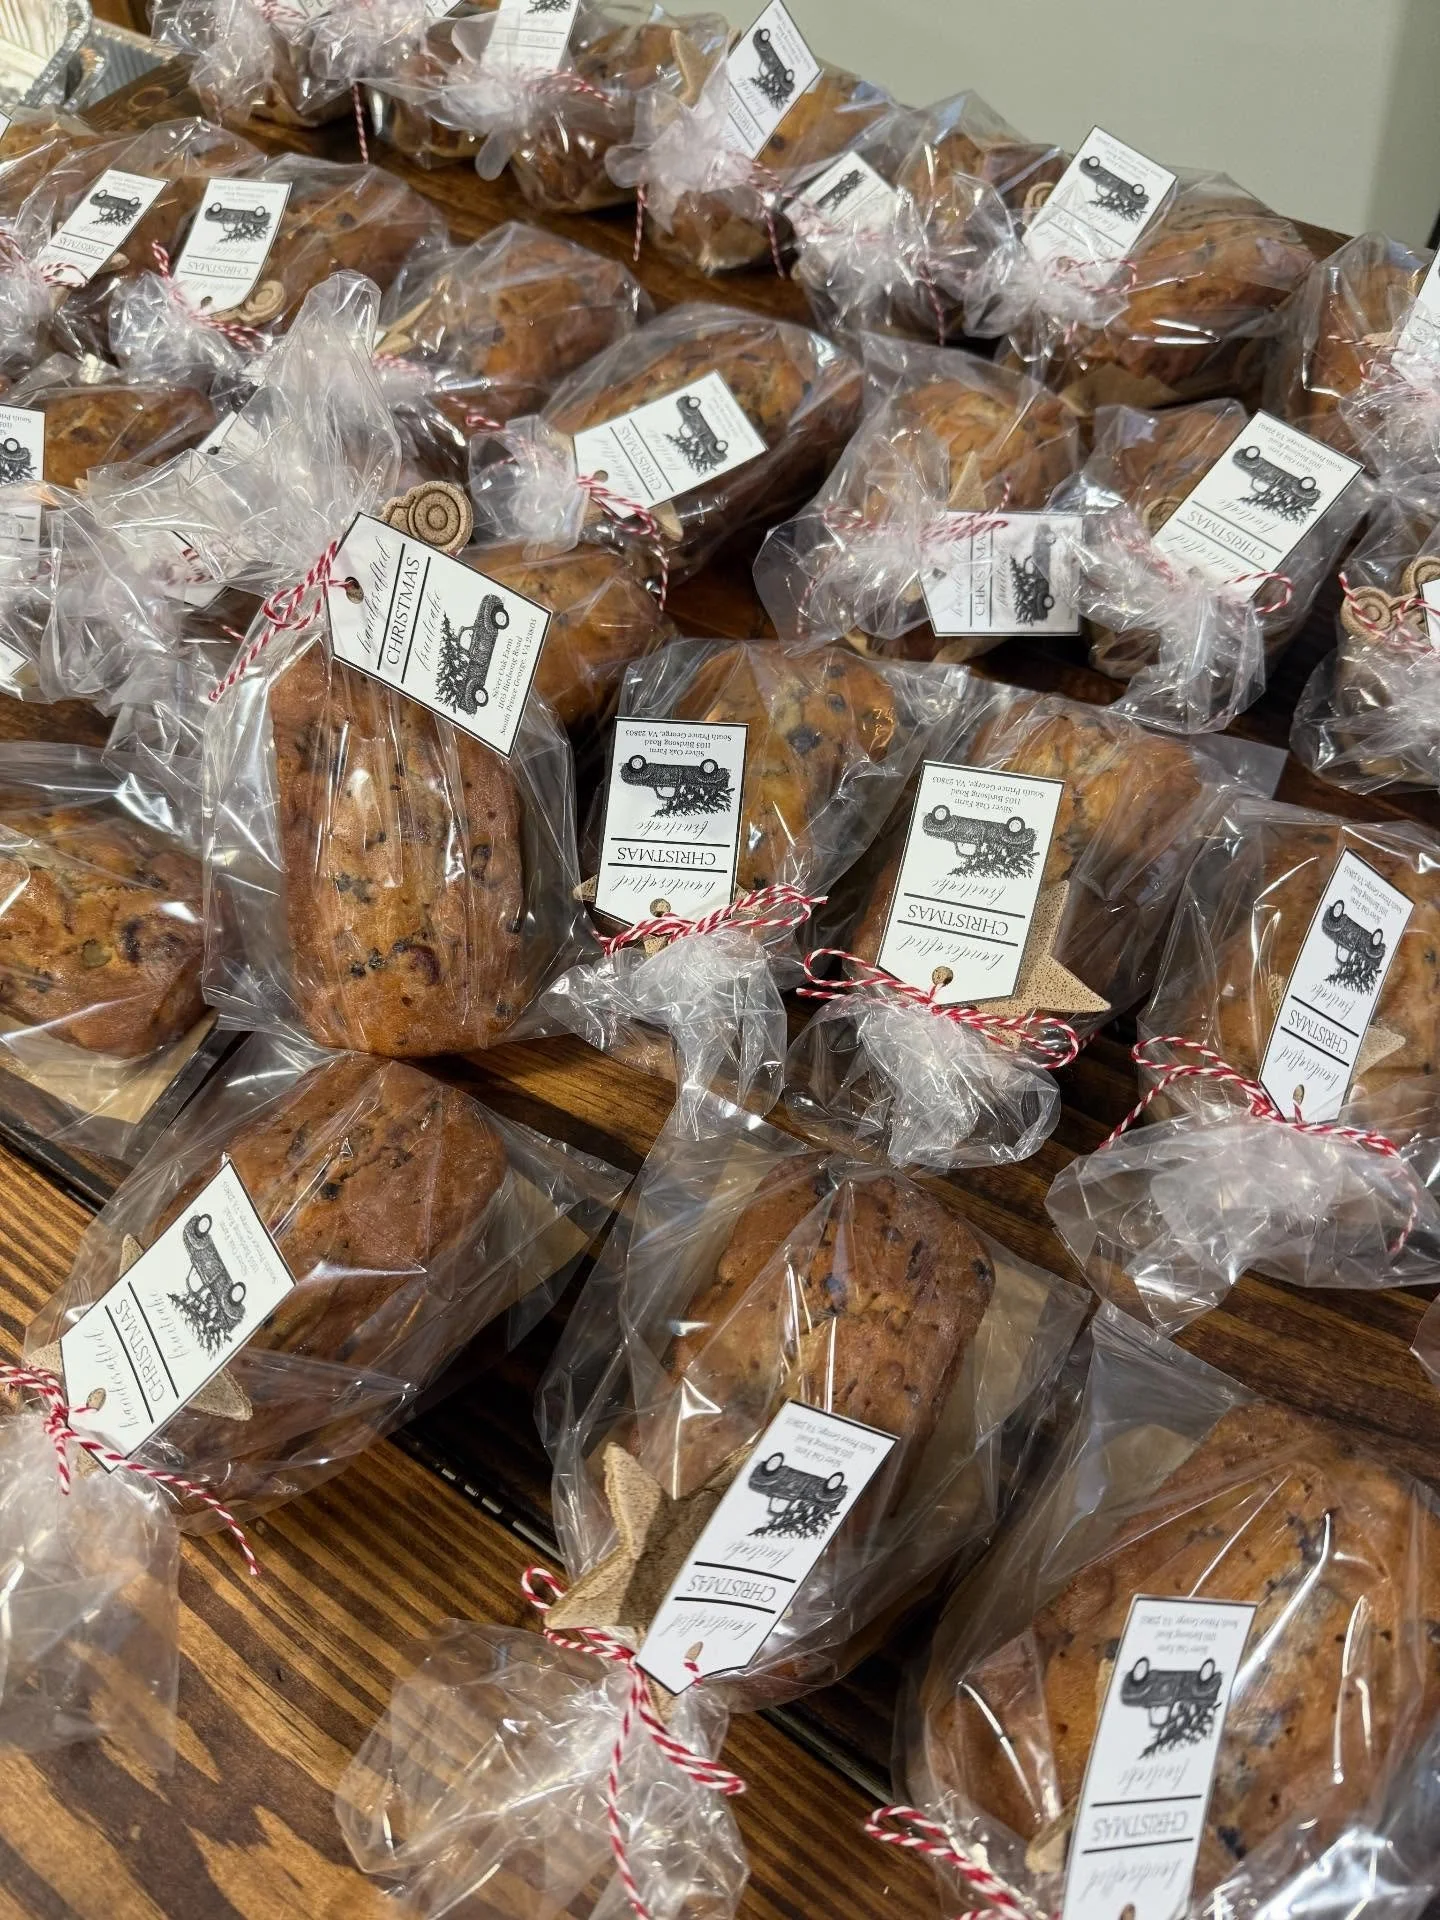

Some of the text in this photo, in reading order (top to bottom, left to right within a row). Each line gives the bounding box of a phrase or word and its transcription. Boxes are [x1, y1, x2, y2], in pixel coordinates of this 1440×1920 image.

[57, 237, 104, 254] CHRISTMAS
[187, 261, 248, 275] CHRISTMAS
[618, 427, 661, 489] CHRISTMAS
[1217, 499, 1278, 534] fruitcake
[1186, 510, 1265, 559] CHRISTMAS
[357, 537, 390, 654] handcrafted
[386, 555, 419, 664] CHRISTMAS
[413, 590, 441, 671] fruitcake
[491, 637, 513, 698] Silver Oak Farm
[501, 657, 518, 692] Birdsong
[511, 635, 522, 657] Road
[499, 712, 511, 733] South
[505, 687, 517, 712] Prince
[520, 644, 530, 654] VA
[664, 739, 694, 748] Birdsong
[687, 732, 709, 740] Prince
[711, 733, 731, 741] South
[649, 747, 667, 755] Farm
[950, 788, 969, 797] Road
[955, 778, 965, 787] VA
[970, 789, 1003, 802] Birdsong
[996, 785, 1021, 795] Prince
[1022, 788, 1044, 798] South
[954, 797, 1012, 813] Silver Oak Farm
[637, 820, 708, 840] fruitcake
[617, 846, 715, 865] CHRISTMAS
[611, 873, 715, 898] handcrafted
[931, 878, 1006, 905] fruitcake
[907, 904, 1008, 935] CHRISTMAS
[897, 934, 1004, 970] handcrafted
[1311, 984, 1356, 1019] fruitcake
[1287, 1009, 1347, 1054] CHRISTMAS
[1271, 1047, 1337, 1093] handcrafted
[145, 1289, 190, 1359] fruitcake
[115, 1299, 164, 1401] CHRISTMAS
[85, 1329, 140, 1428] handcrafted
[686, 1575, 777, 1603] CHRISTMAS
[1092, 1811, 1187, 1840] CHRISTMAS
